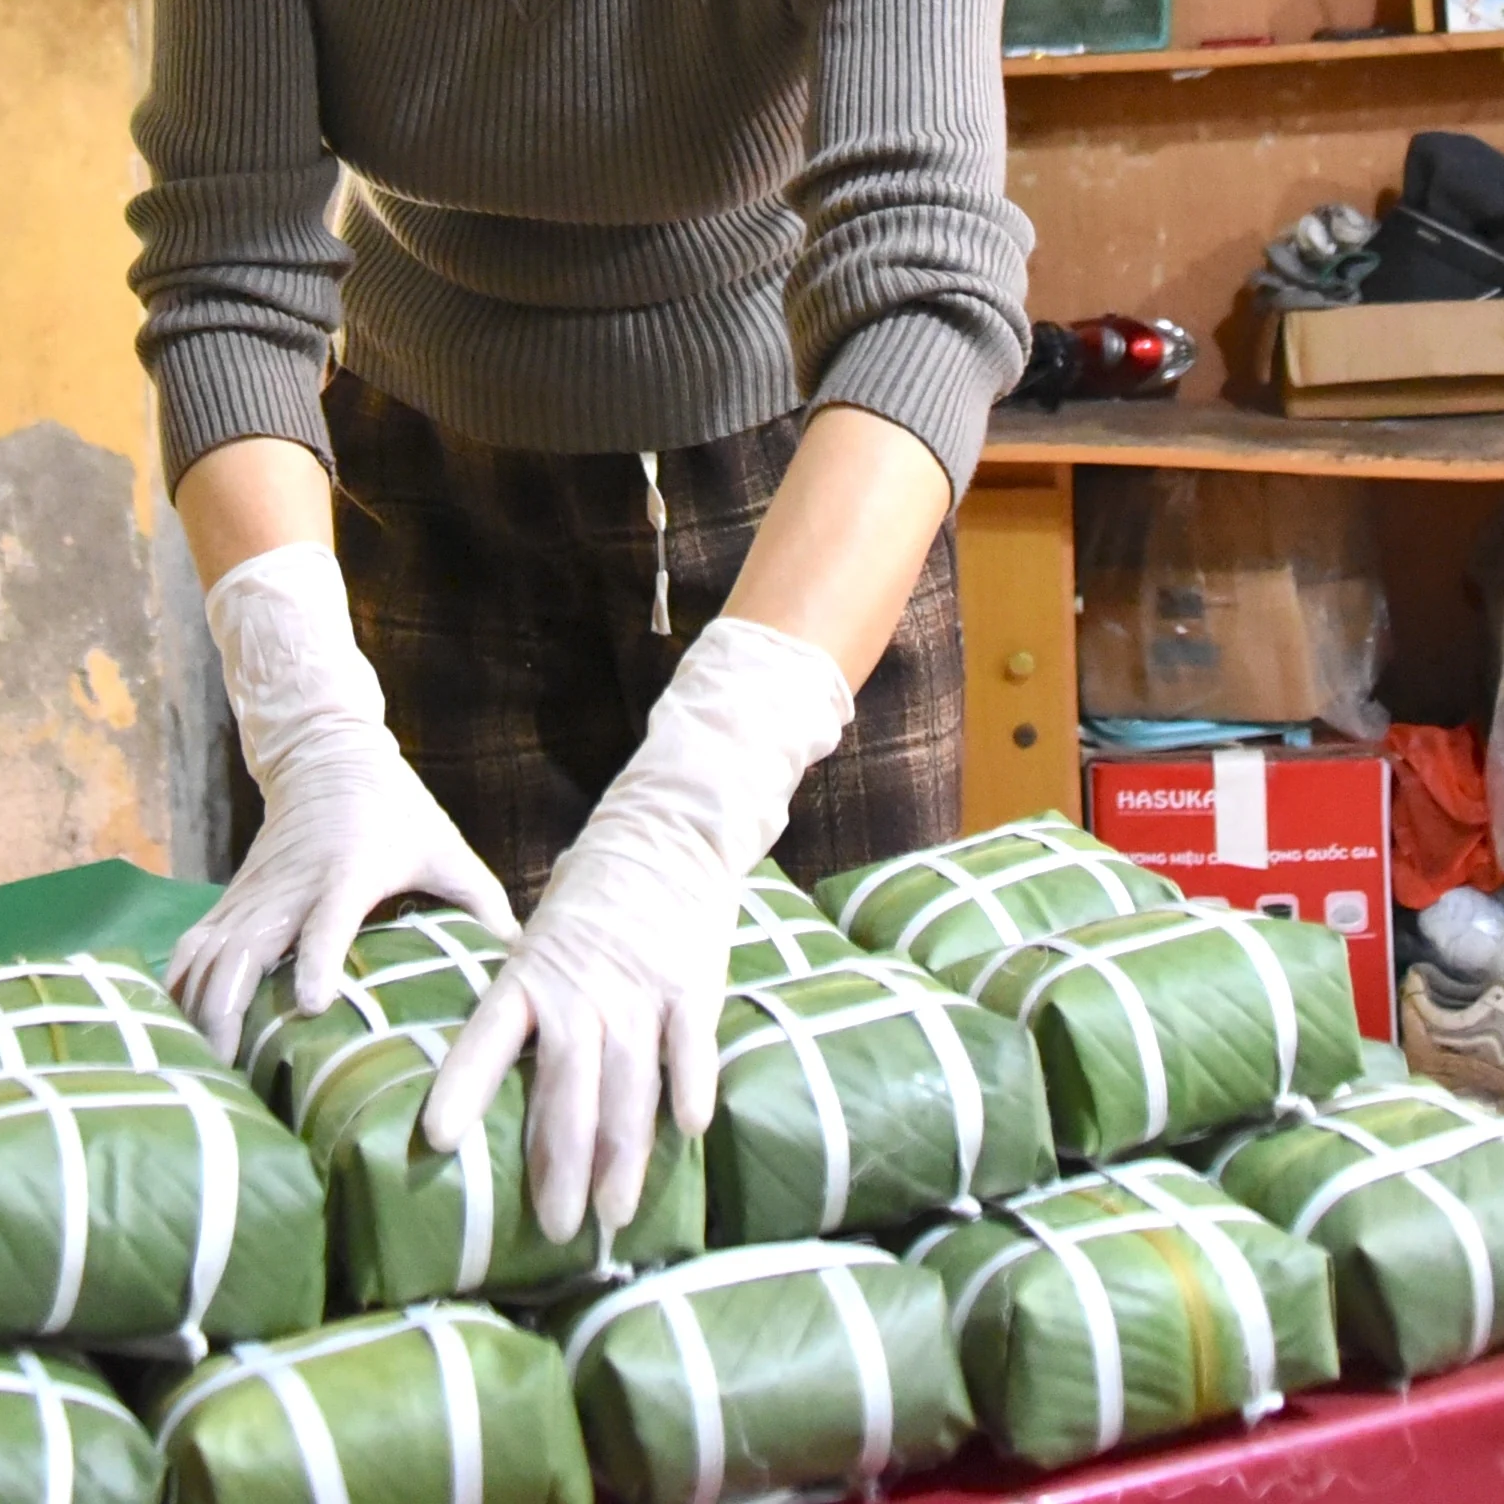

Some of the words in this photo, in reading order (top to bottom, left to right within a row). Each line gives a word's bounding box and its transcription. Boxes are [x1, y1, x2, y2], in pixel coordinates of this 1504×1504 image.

[1117, 789, 1216, 809] HASUKA
[1304, 843, 1348, 862] QUỐC
[1351, 846, 1377, 860] GIA
